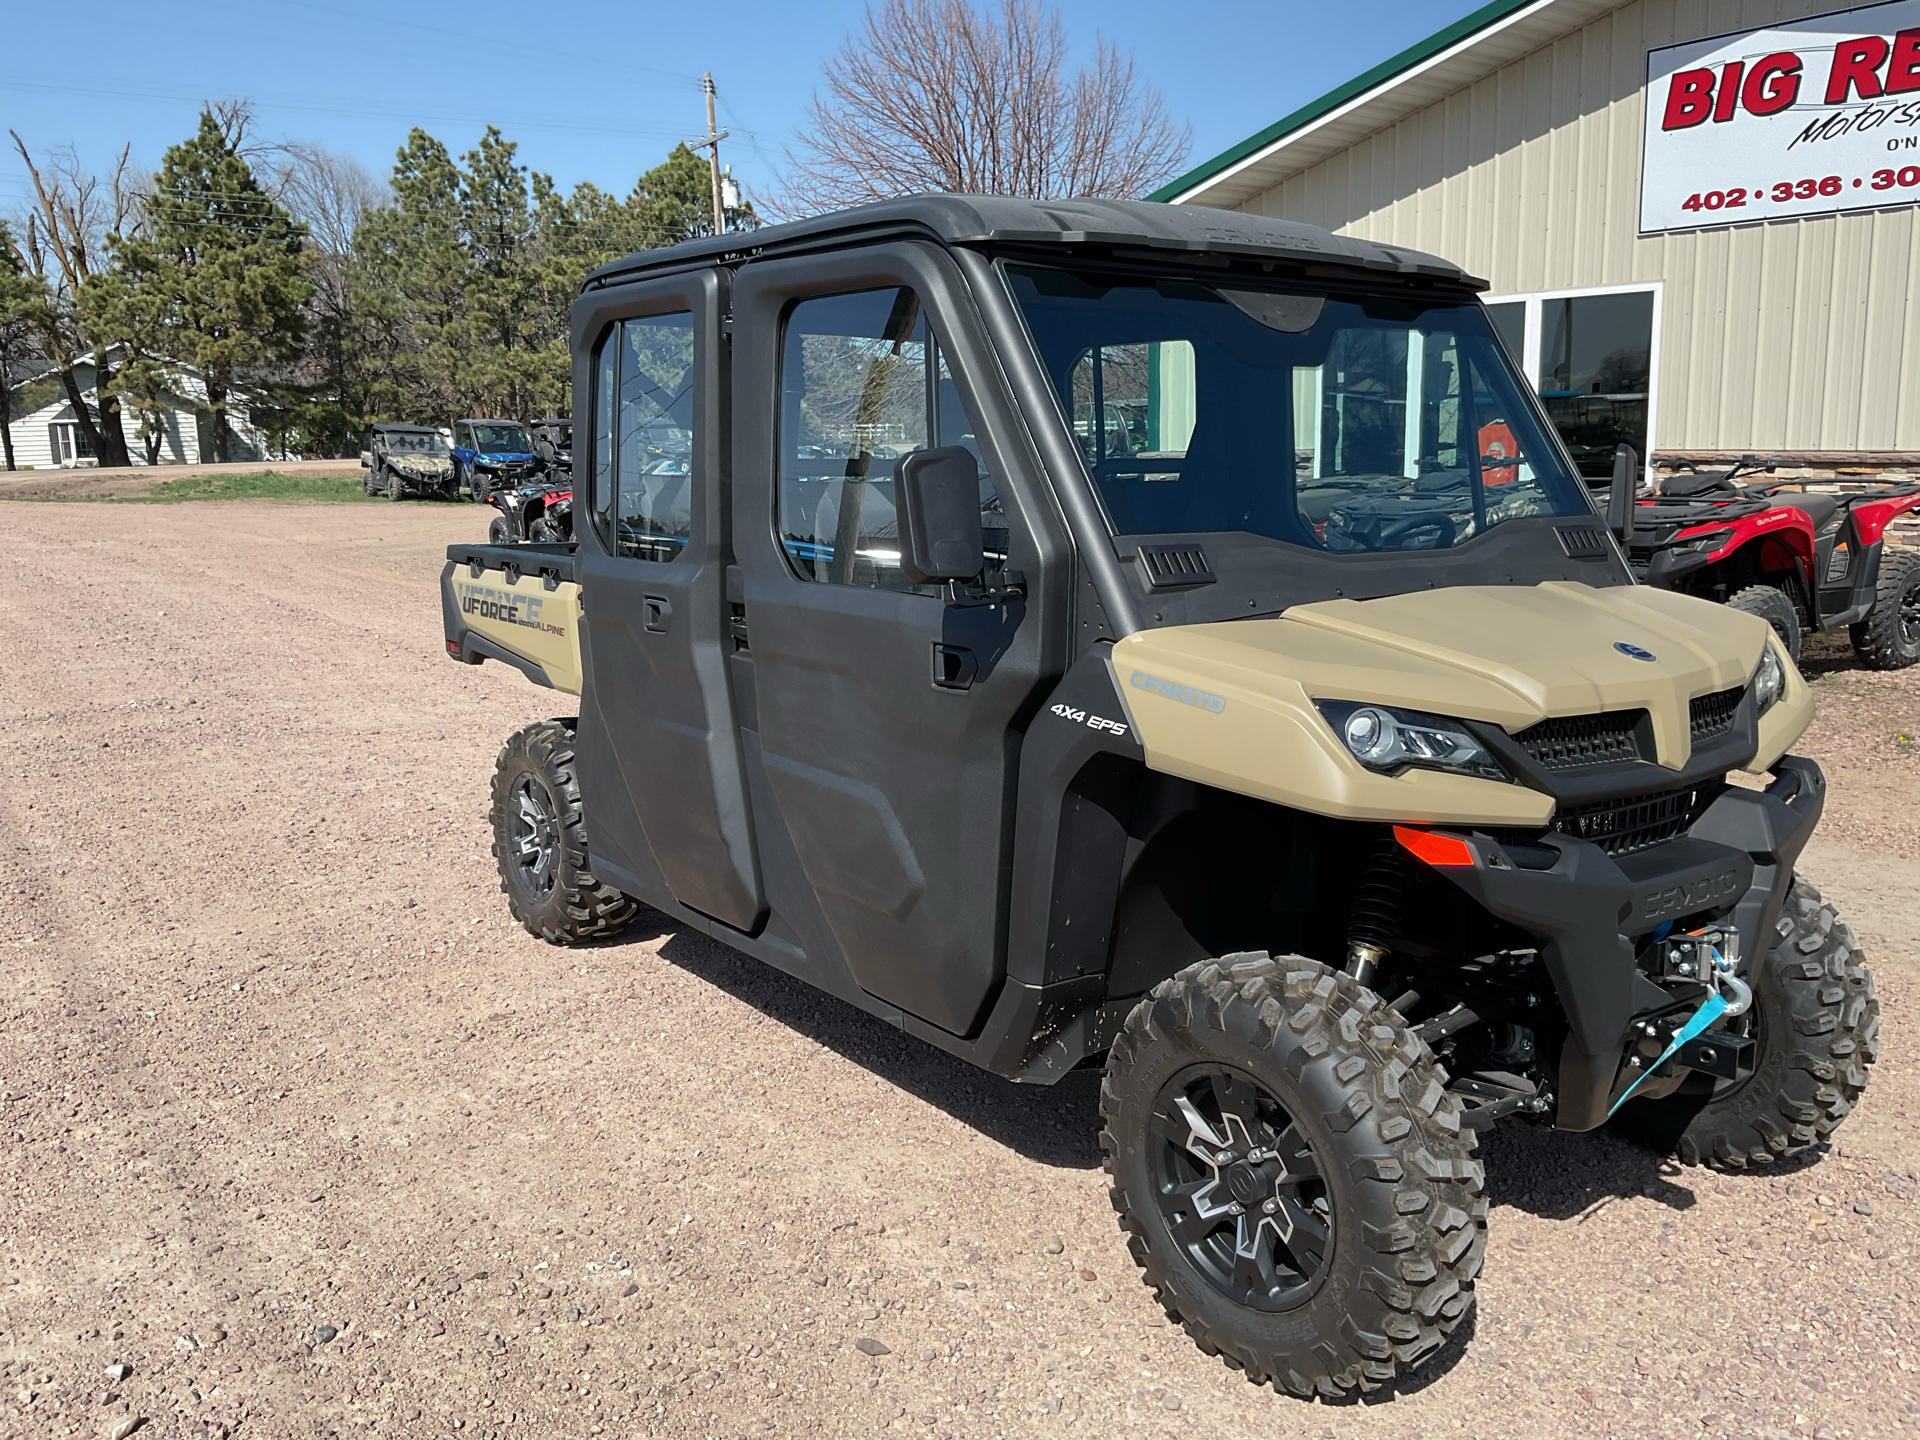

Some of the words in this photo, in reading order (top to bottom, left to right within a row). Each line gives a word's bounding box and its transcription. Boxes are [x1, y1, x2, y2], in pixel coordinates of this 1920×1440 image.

[1662, 52, 1804, 131] BIG
[1682, 188, 1747, 212] 402
[1771, 176, 1842, 202] 336
[463, 596, 518, 624] UFORCE
[536, 622, 565, 637] ALPINE
[1130, 671, 1226, 713] CFMOTO
[1051, 704, 1086, 723] 4X4
[1086, 715, 1128, 736] EPS
[1645, 869, 1736, 918] CFMOTO
